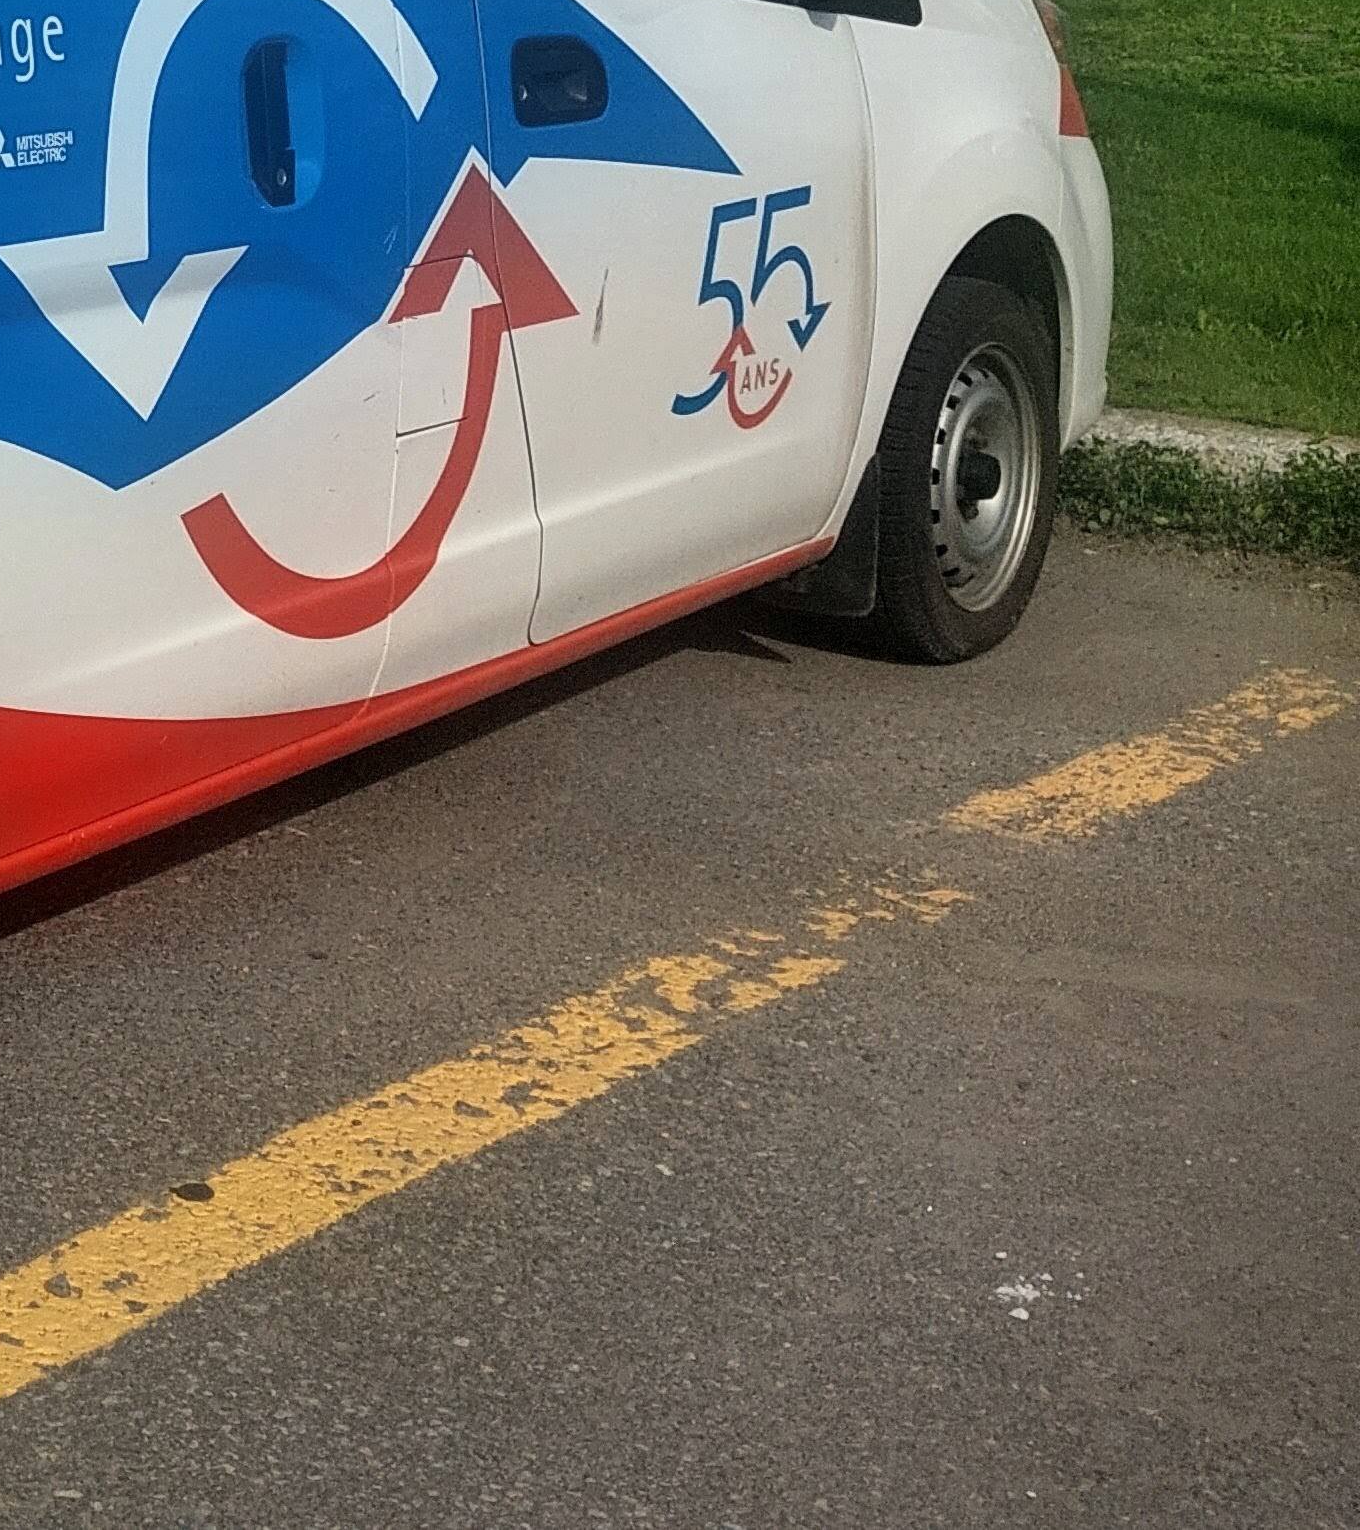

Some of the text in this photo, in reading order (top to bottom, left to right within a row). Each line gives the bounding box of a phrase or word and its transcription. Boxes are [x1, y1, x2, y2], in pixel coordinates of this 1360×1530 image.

[16, 130, 73, 151] MITSUBISHI
[17, 147, 67, 167] ELECTRIC
[740, 357, 781, 395] ANS
